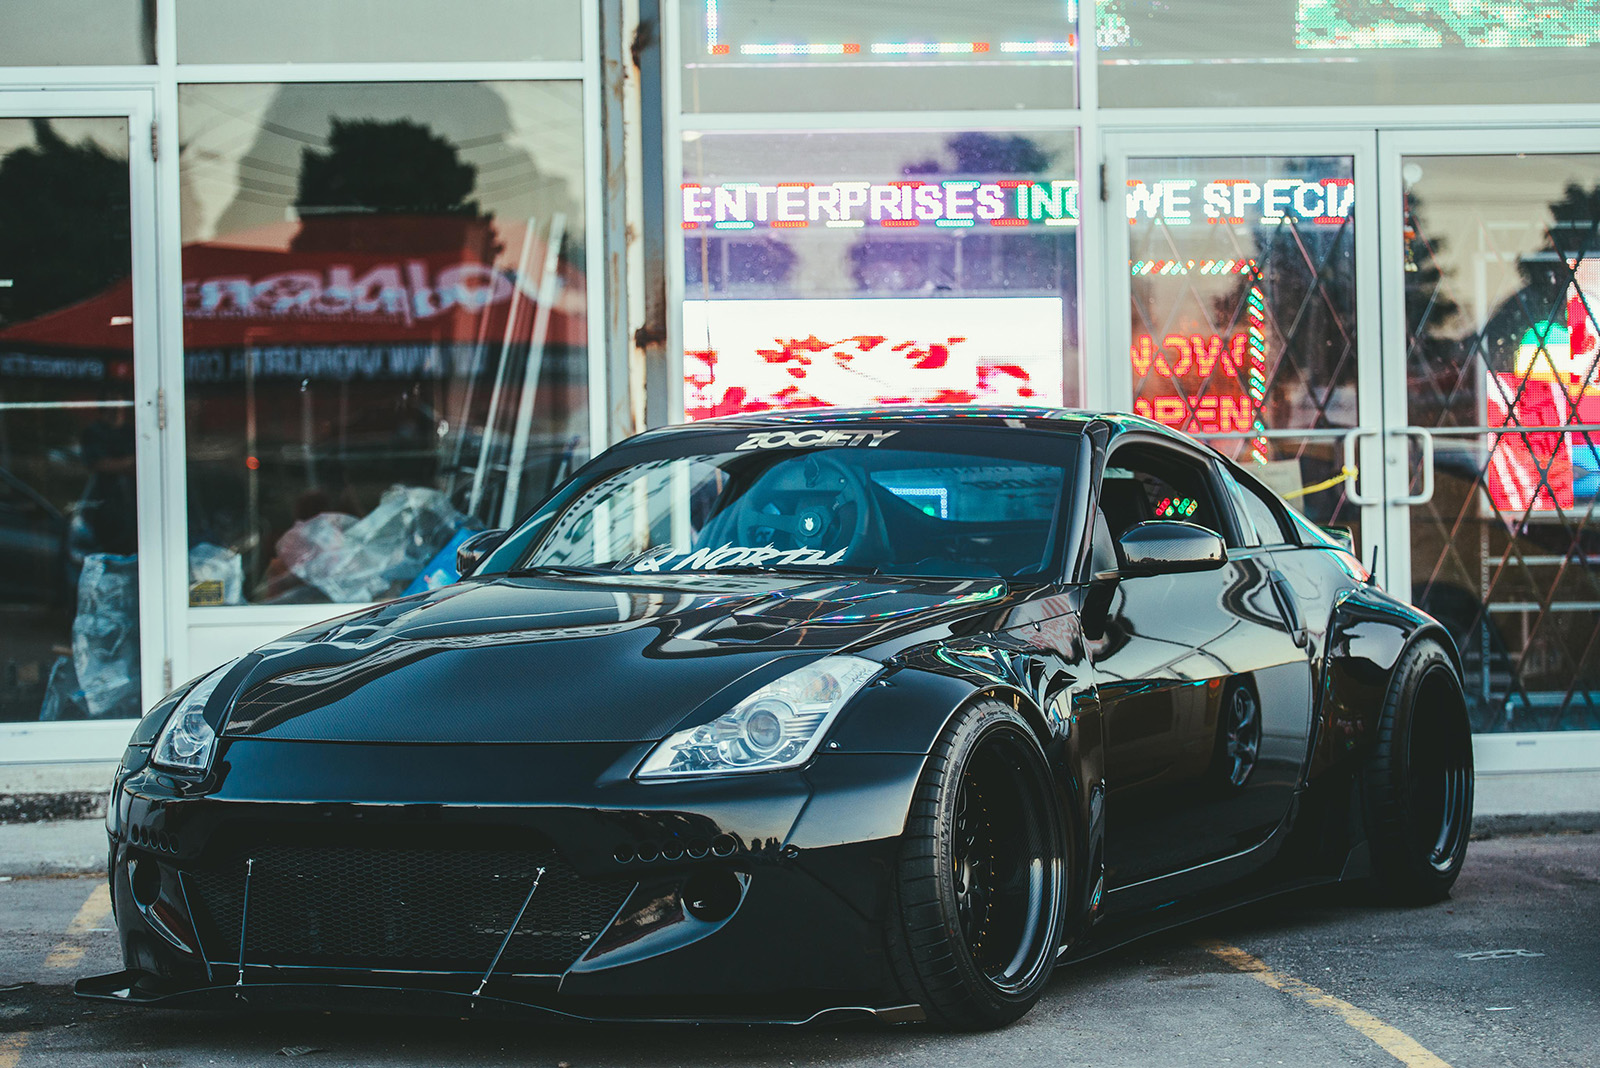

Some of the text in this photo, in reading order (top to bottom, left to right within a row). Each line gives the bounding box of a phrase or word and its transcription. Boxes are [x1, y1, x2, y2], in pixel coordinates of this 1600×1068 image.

[683, 184, 1004, 221] ENTERPRISES
[1126, 183, 1191, 218] WE
[735, 429, 900, 451] ZOCIETY
